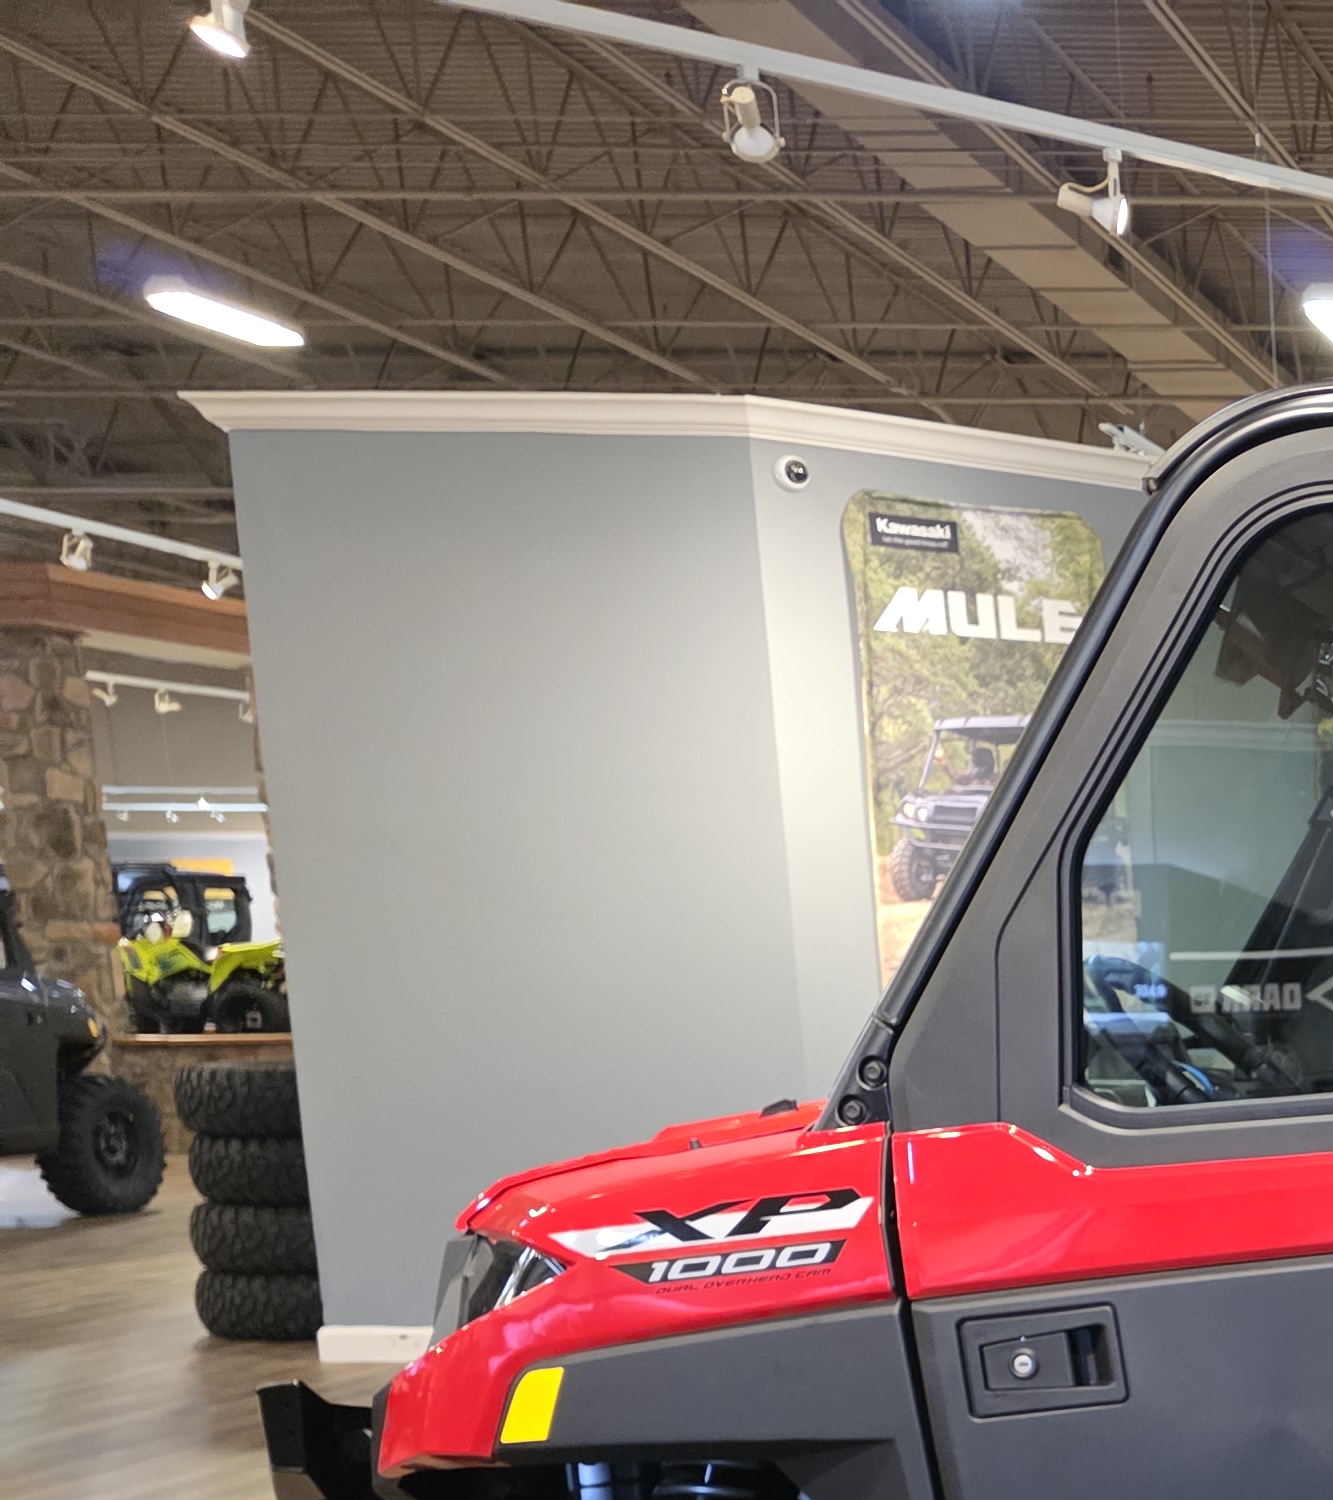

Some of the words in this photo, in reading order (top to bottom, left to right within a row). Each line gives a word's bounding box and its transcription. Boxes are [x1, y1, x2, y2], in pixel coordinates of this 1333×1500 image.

[876, 517, 951, 541] Kawasaki
[873, 587, 1083, 644] MULE
[634, 1188, 862, 1242] XP
[648, 1242, 831, 1282] 1000
[655, 1284, 699, 1294] DUAL
[703, 1273, 791, 1289] OVERHEAD
[795, 1268, 832, 1279] CAM
